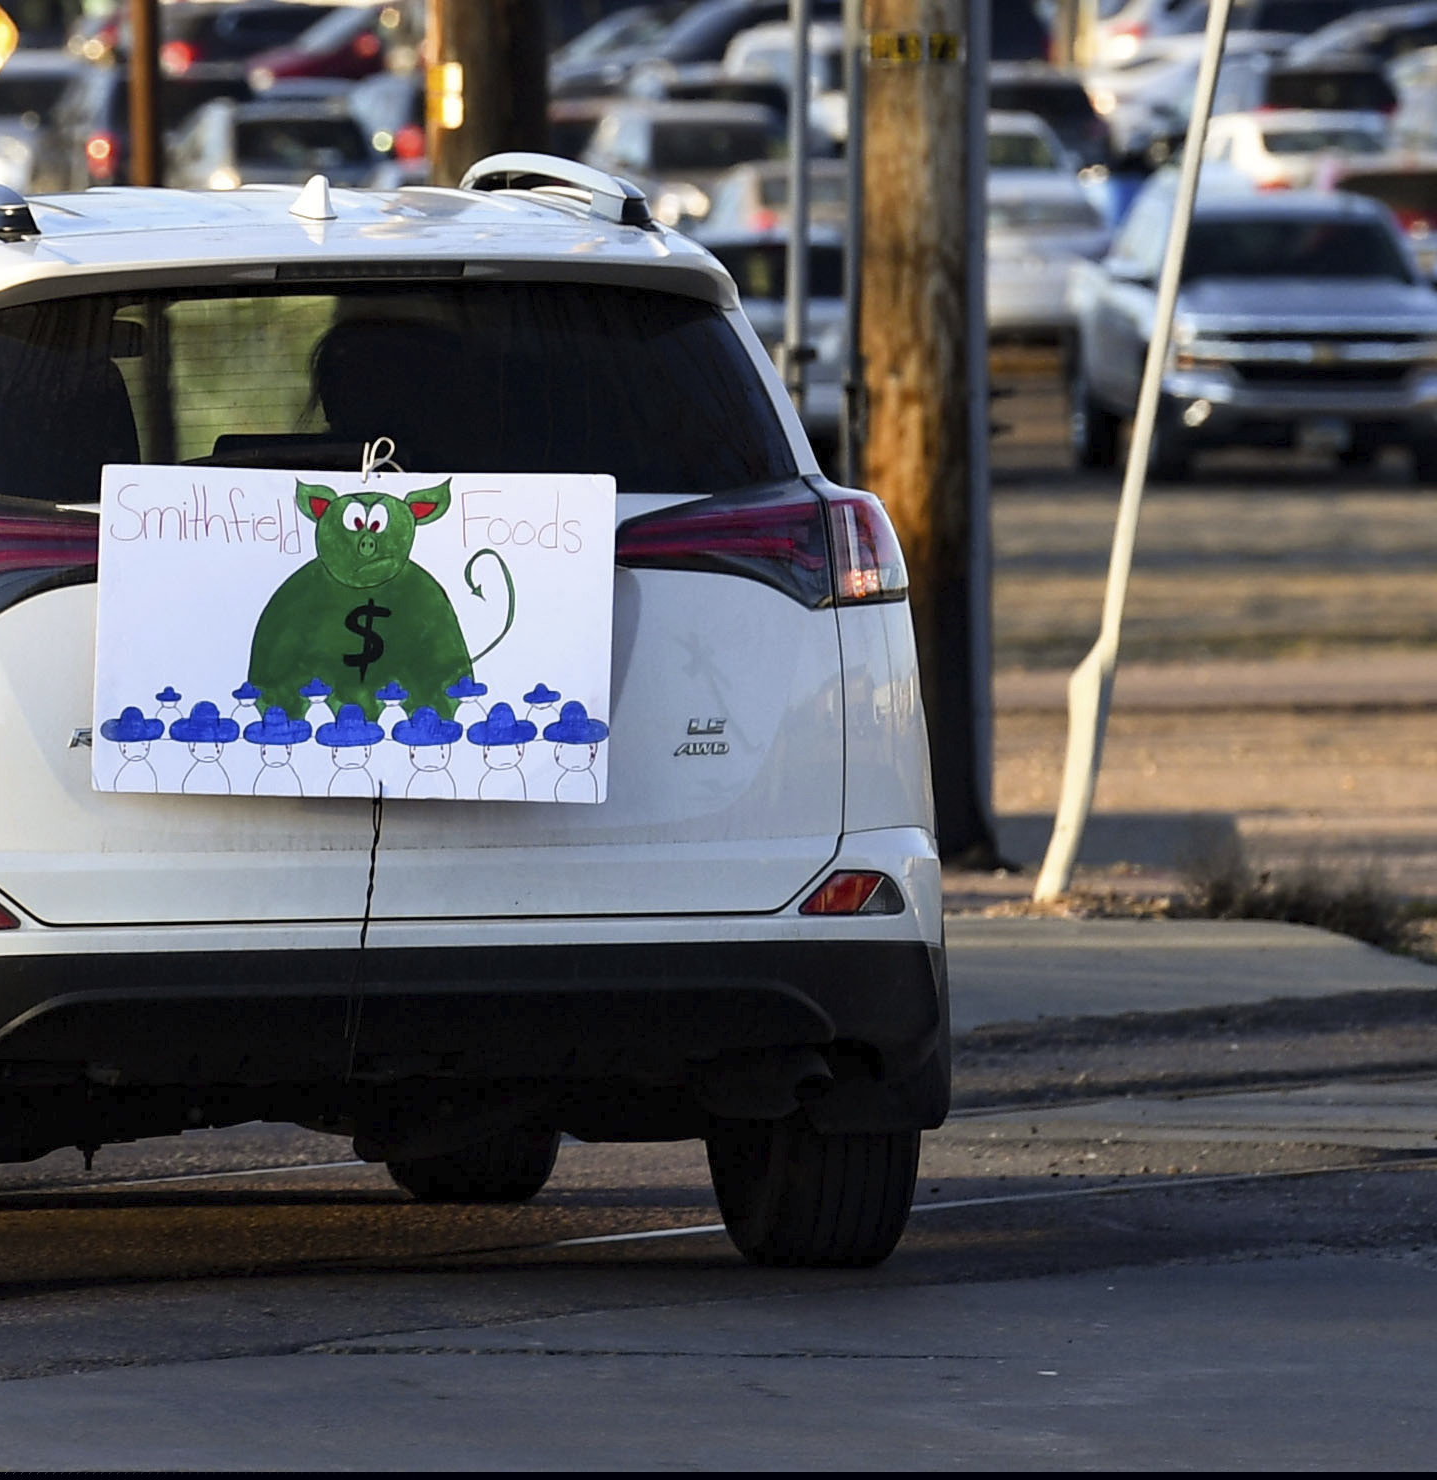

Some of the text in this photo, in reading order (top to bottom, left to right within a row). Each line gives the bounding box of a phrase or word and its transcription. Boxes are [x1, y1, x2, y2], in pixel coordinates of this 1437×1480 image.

[109, 481, 584, 556] Smithfield Foods
[687, 717, 727, 735] LE
[673, 741, 730, 757] AWD
